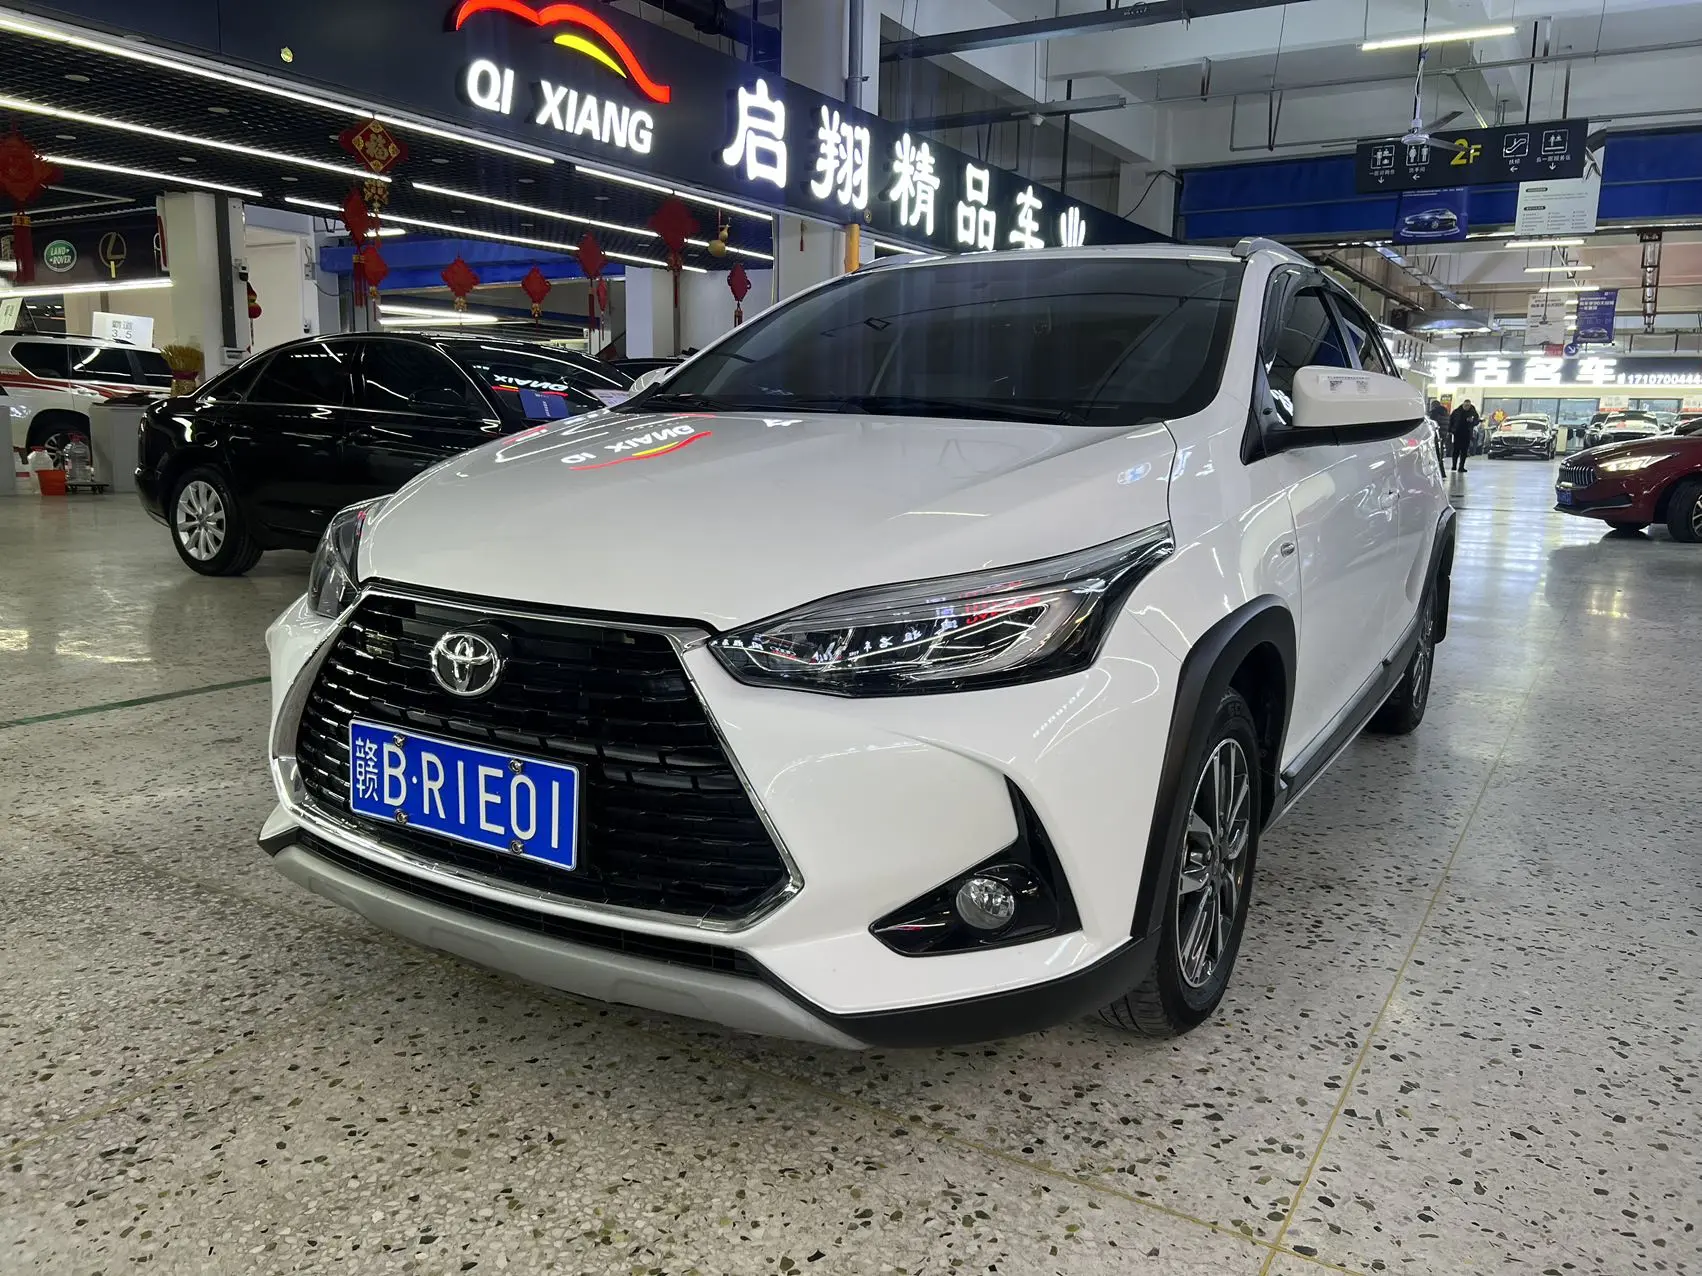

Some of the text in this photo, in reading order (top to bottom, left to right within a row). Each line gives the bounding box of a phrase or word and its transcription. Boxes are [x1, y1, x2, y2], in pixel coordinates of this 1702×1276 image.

[467, 59, 654, 154] QI XIANG
[1450, 138, 1482, 166] 2F
[722, 78, 1086, 250] 启翔精品车业
[50, 247, 67, 256] LAND
[52, 254, 72, 265] ROVER
[1628, 373, 1702, 385] 1710700444
